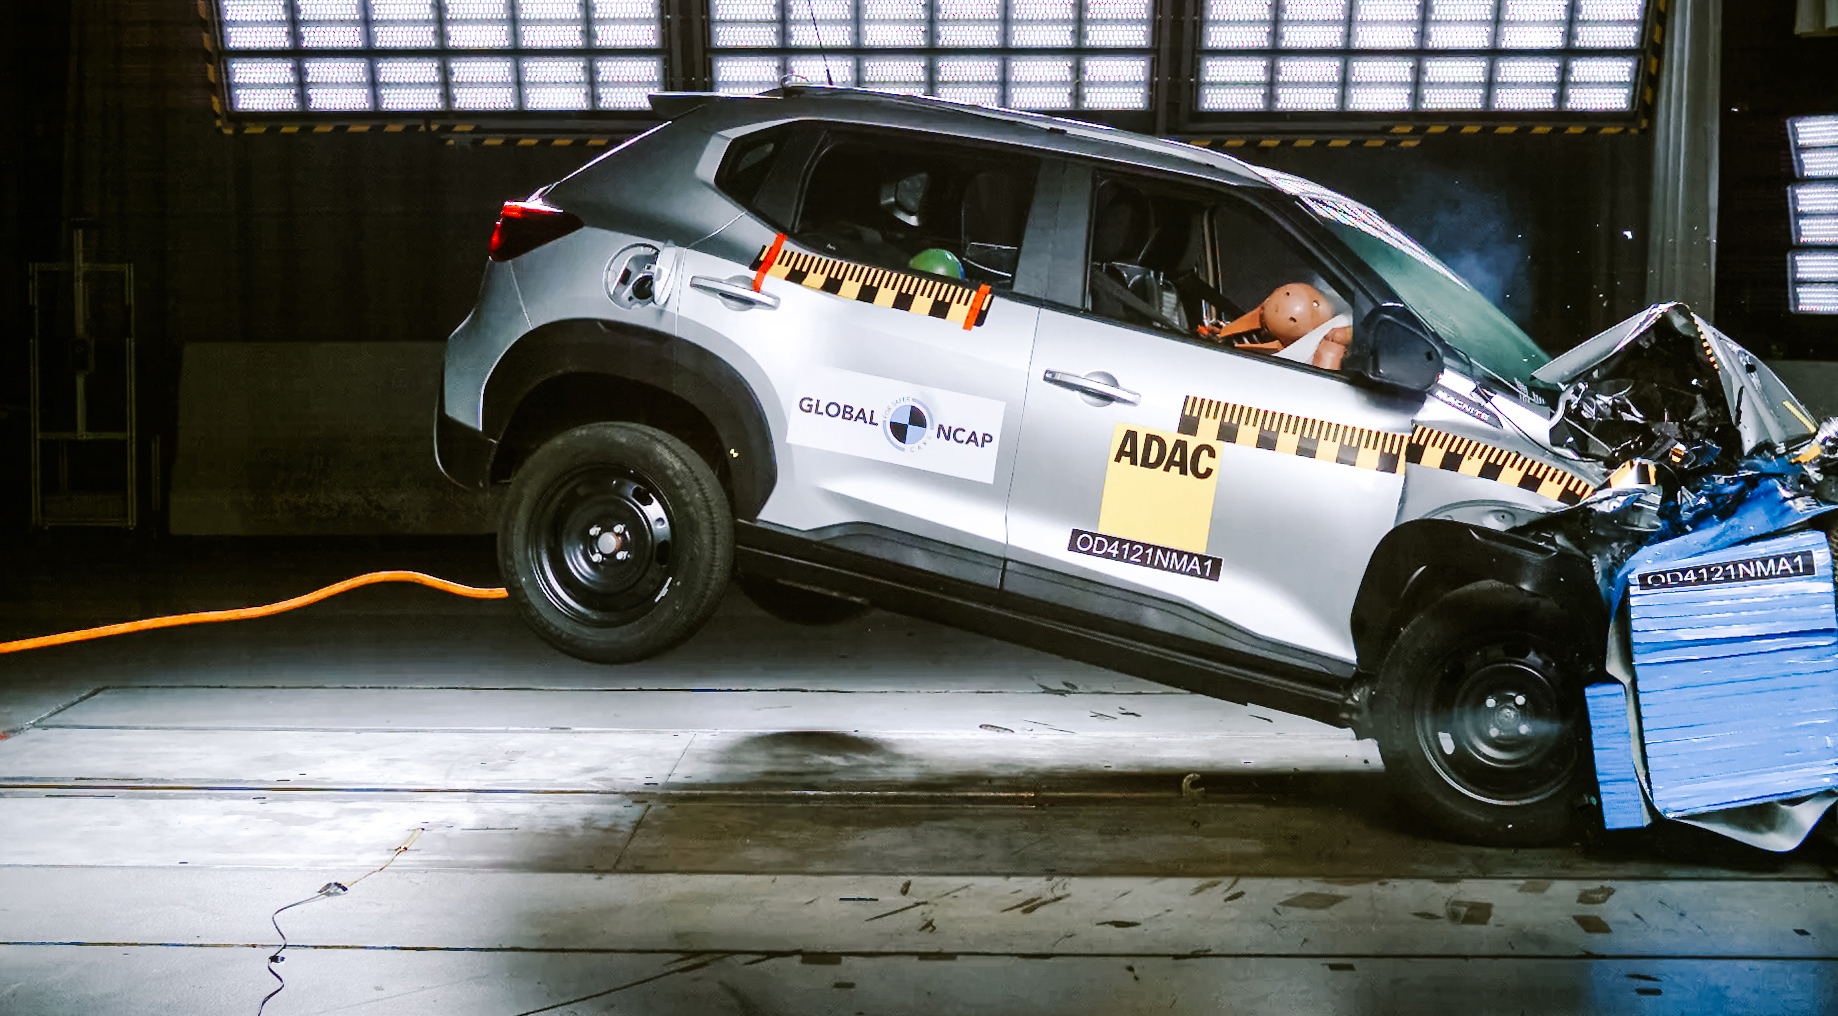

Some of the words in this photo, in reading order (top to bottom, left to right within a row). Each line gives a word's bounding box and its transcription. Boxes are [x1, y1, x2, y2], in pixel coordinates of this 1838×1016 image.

[799, 397, 878, 426] GLOBAL
[936, 424, 993, 448] NCAP
[1114, 429, 1216, 479] ADAC
[1077, 533, 1212, 577] OD4121NMA1
[1647, 554, 1804, 587] OD4121NMA1
